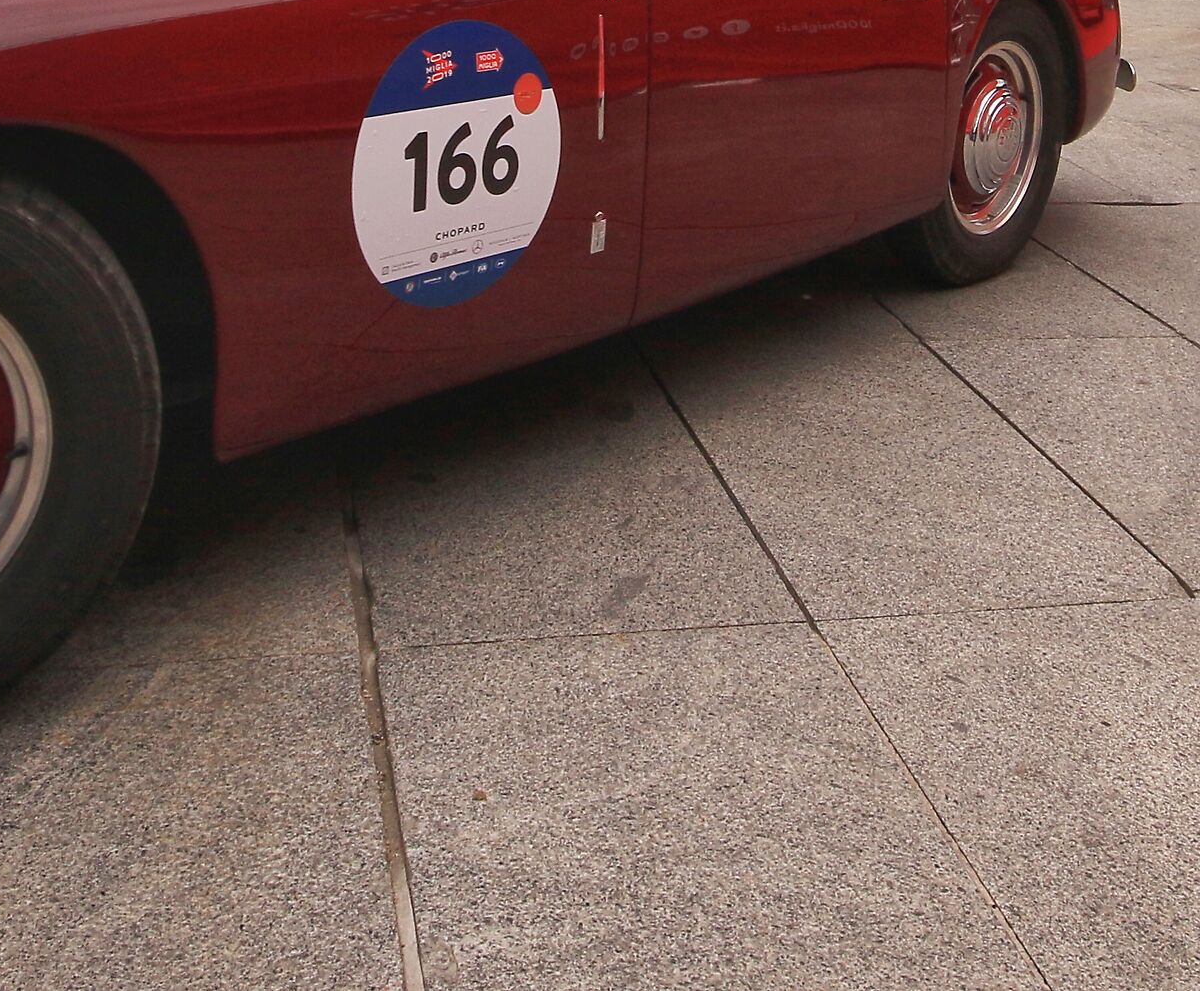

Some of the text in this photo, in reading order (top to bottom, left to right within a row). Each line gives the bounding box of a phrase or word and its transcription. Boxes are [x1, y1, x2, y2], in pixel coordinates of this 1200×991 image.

[426, 50, 453, 64] 1000
[479, 53, 497, 61] 1000
[425, 60, 453, 74] MIGLIA
[426, 70, 453, 84] 2019
[404, 114, 519, 213] 166
[435, 222, 486, 241] CHOPARD
